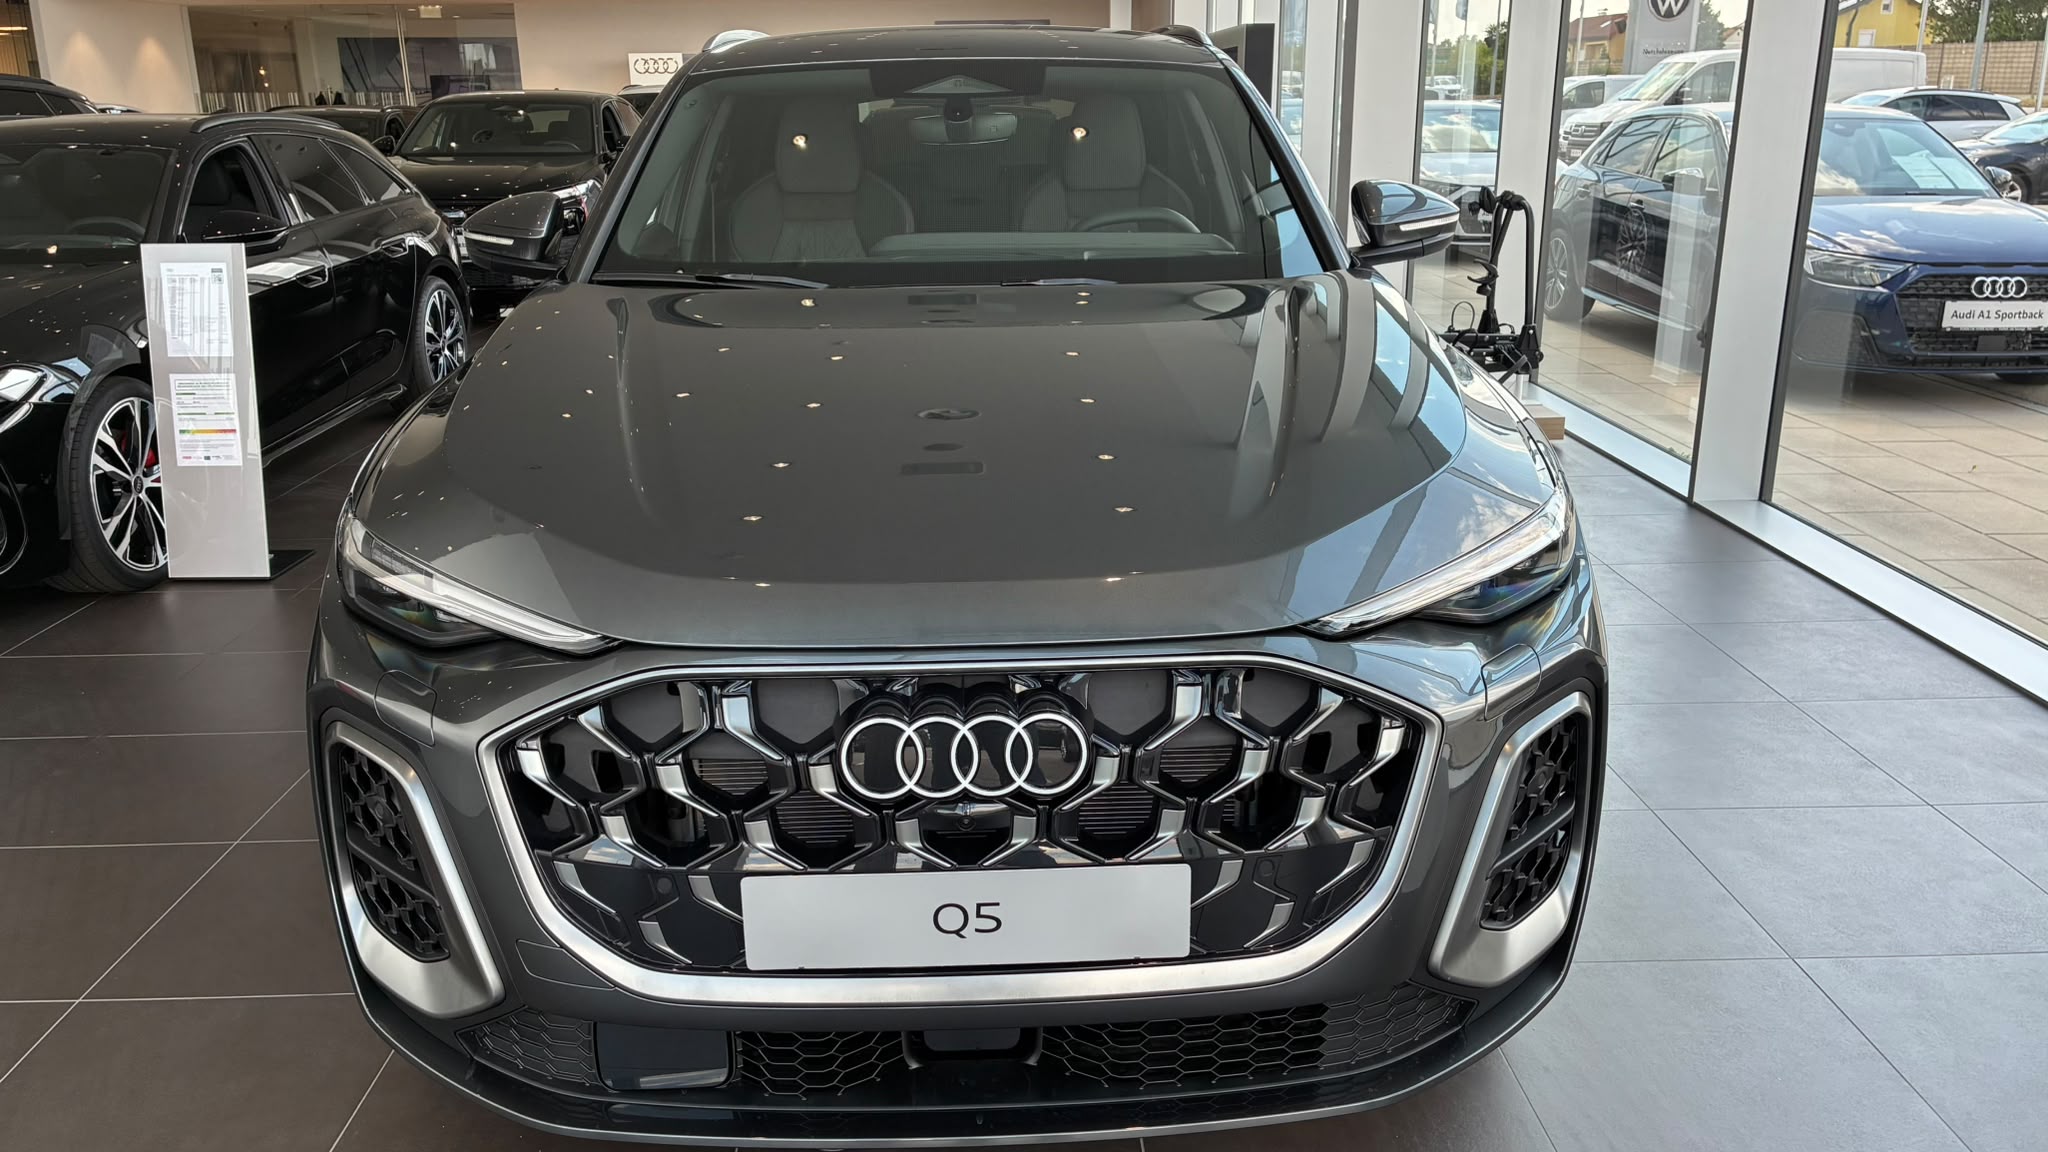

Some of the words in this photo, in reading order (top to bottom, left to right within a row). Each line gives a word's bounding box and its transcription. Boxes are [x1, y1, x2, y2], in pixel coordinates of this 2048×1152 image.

[1951, 309, 1976, 319] Audi
[1977, 310, 1991, 319] A1
[1994, 309, 2044, 321] Sportback
[932, 902, 1002, 939] Q5
